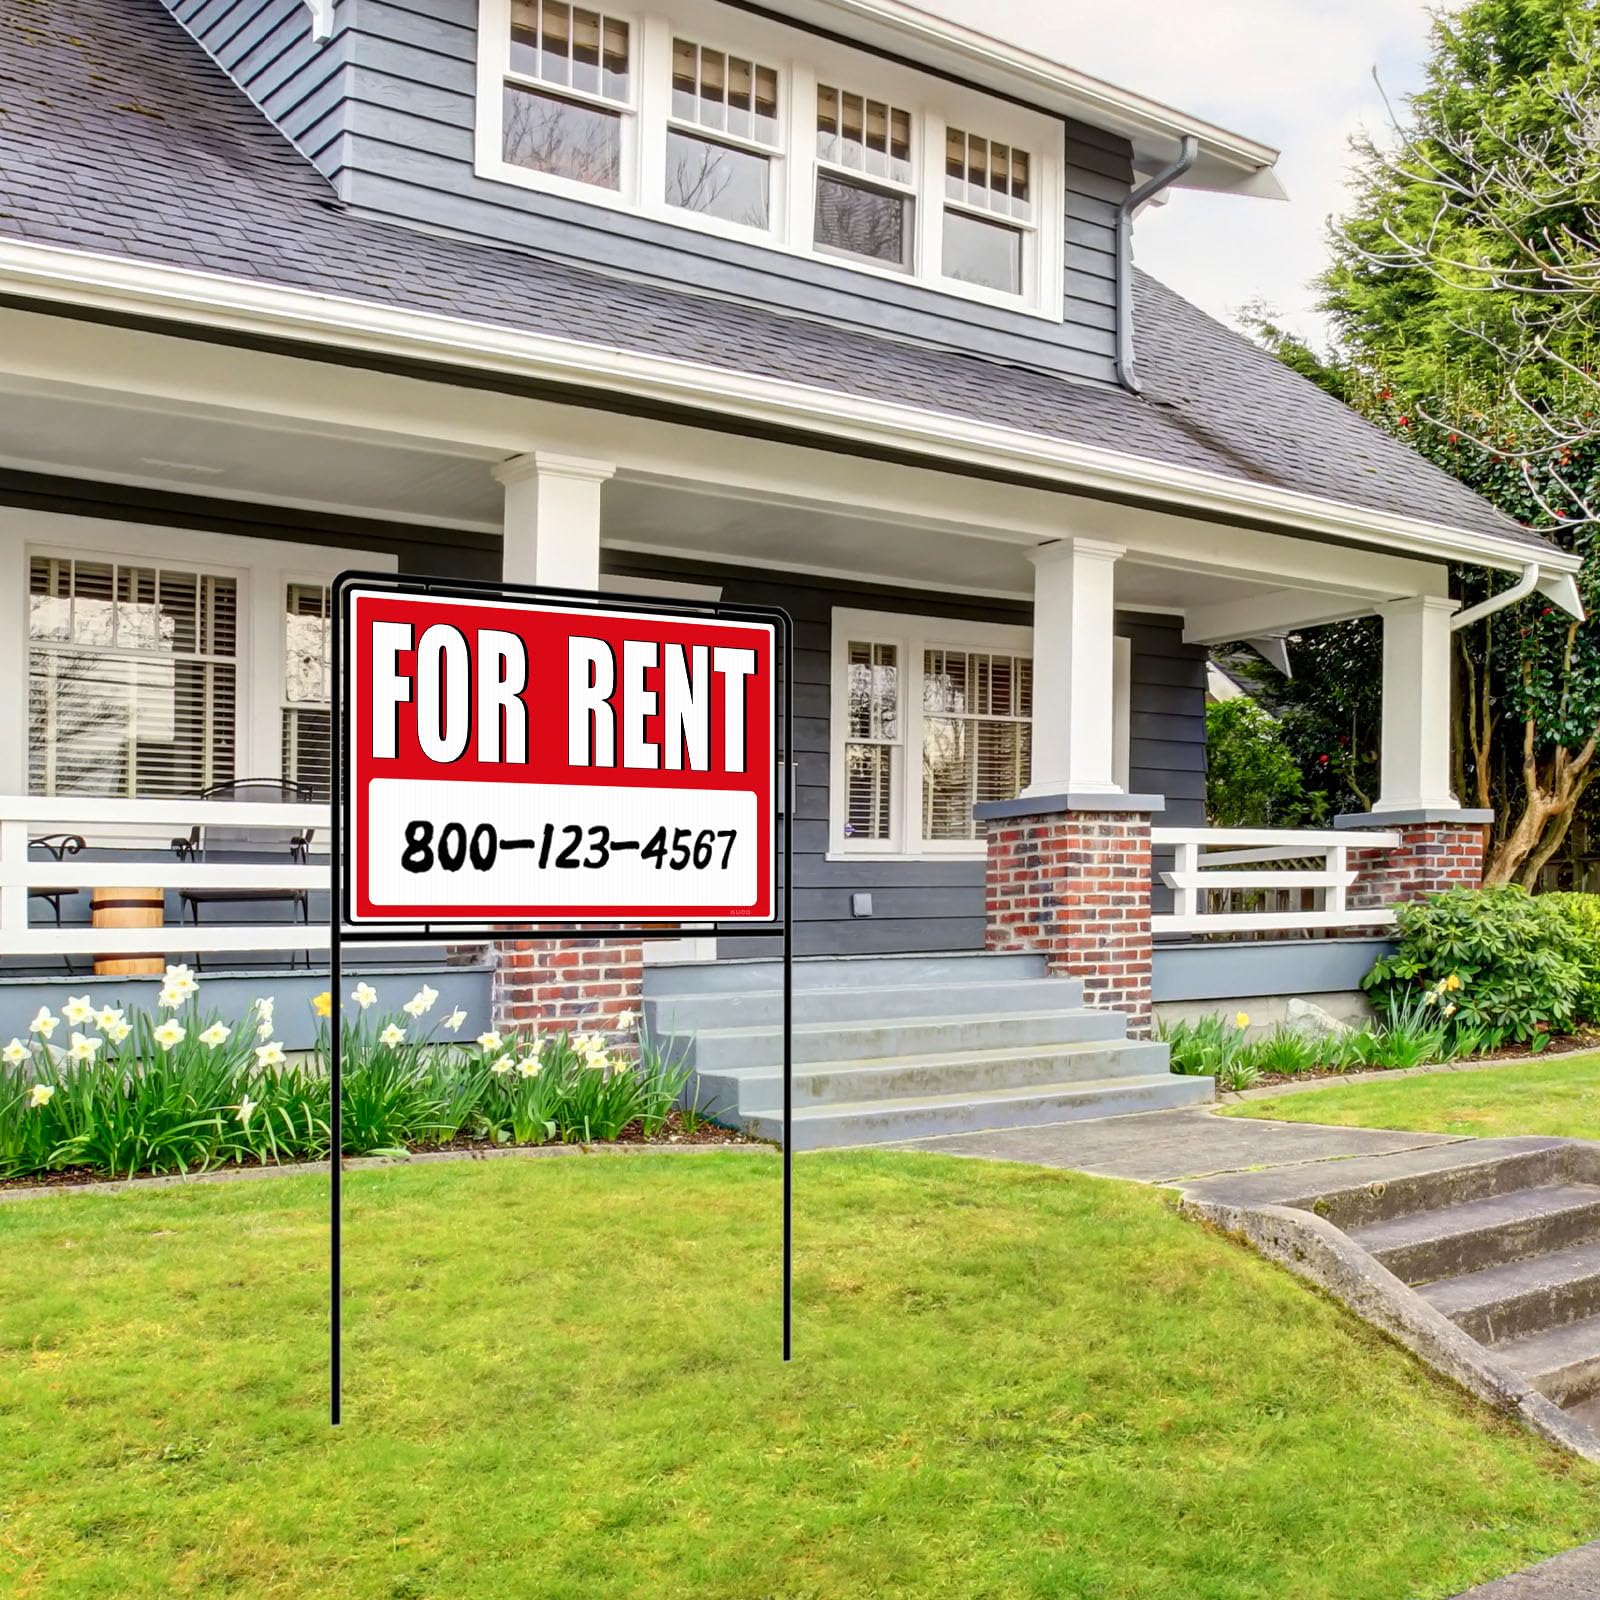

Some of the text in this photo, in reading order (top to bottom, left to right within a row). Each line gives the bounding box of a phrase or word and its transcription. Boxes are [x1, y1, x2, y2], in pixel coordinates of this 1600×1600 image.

[372, 621, 758, 773] FOR RENT
[401, 820, 737, 873] 800-123-4567
